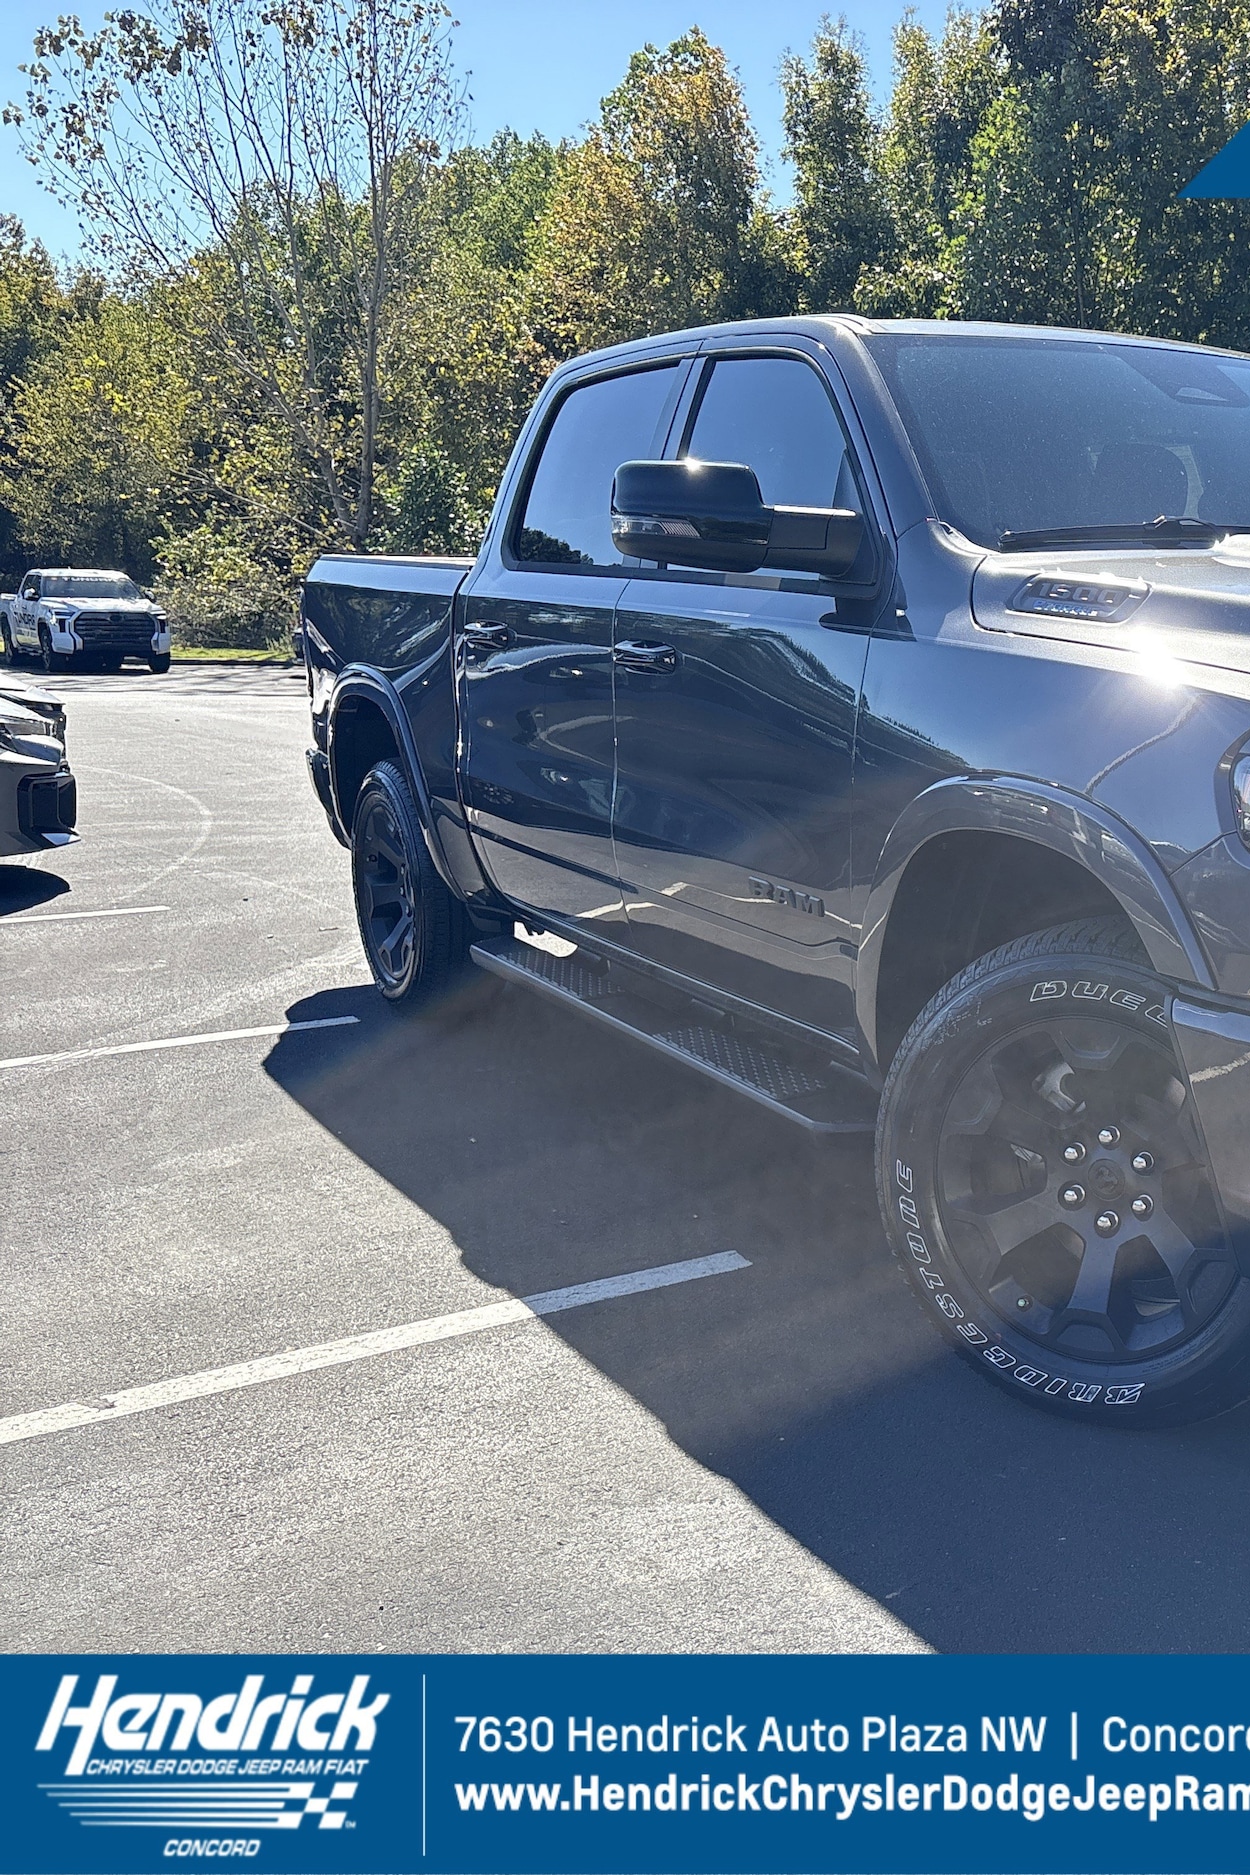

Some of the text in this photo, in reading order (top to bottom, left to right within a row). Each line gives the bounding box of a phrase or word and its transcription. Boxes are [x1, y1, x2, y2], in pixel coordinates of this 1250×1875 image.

[1038, 583, 1124, 604] 1500
[748, 876, 826, 918] RAM
[896, 1158, 1146, 1405] BRIDGESTONE
